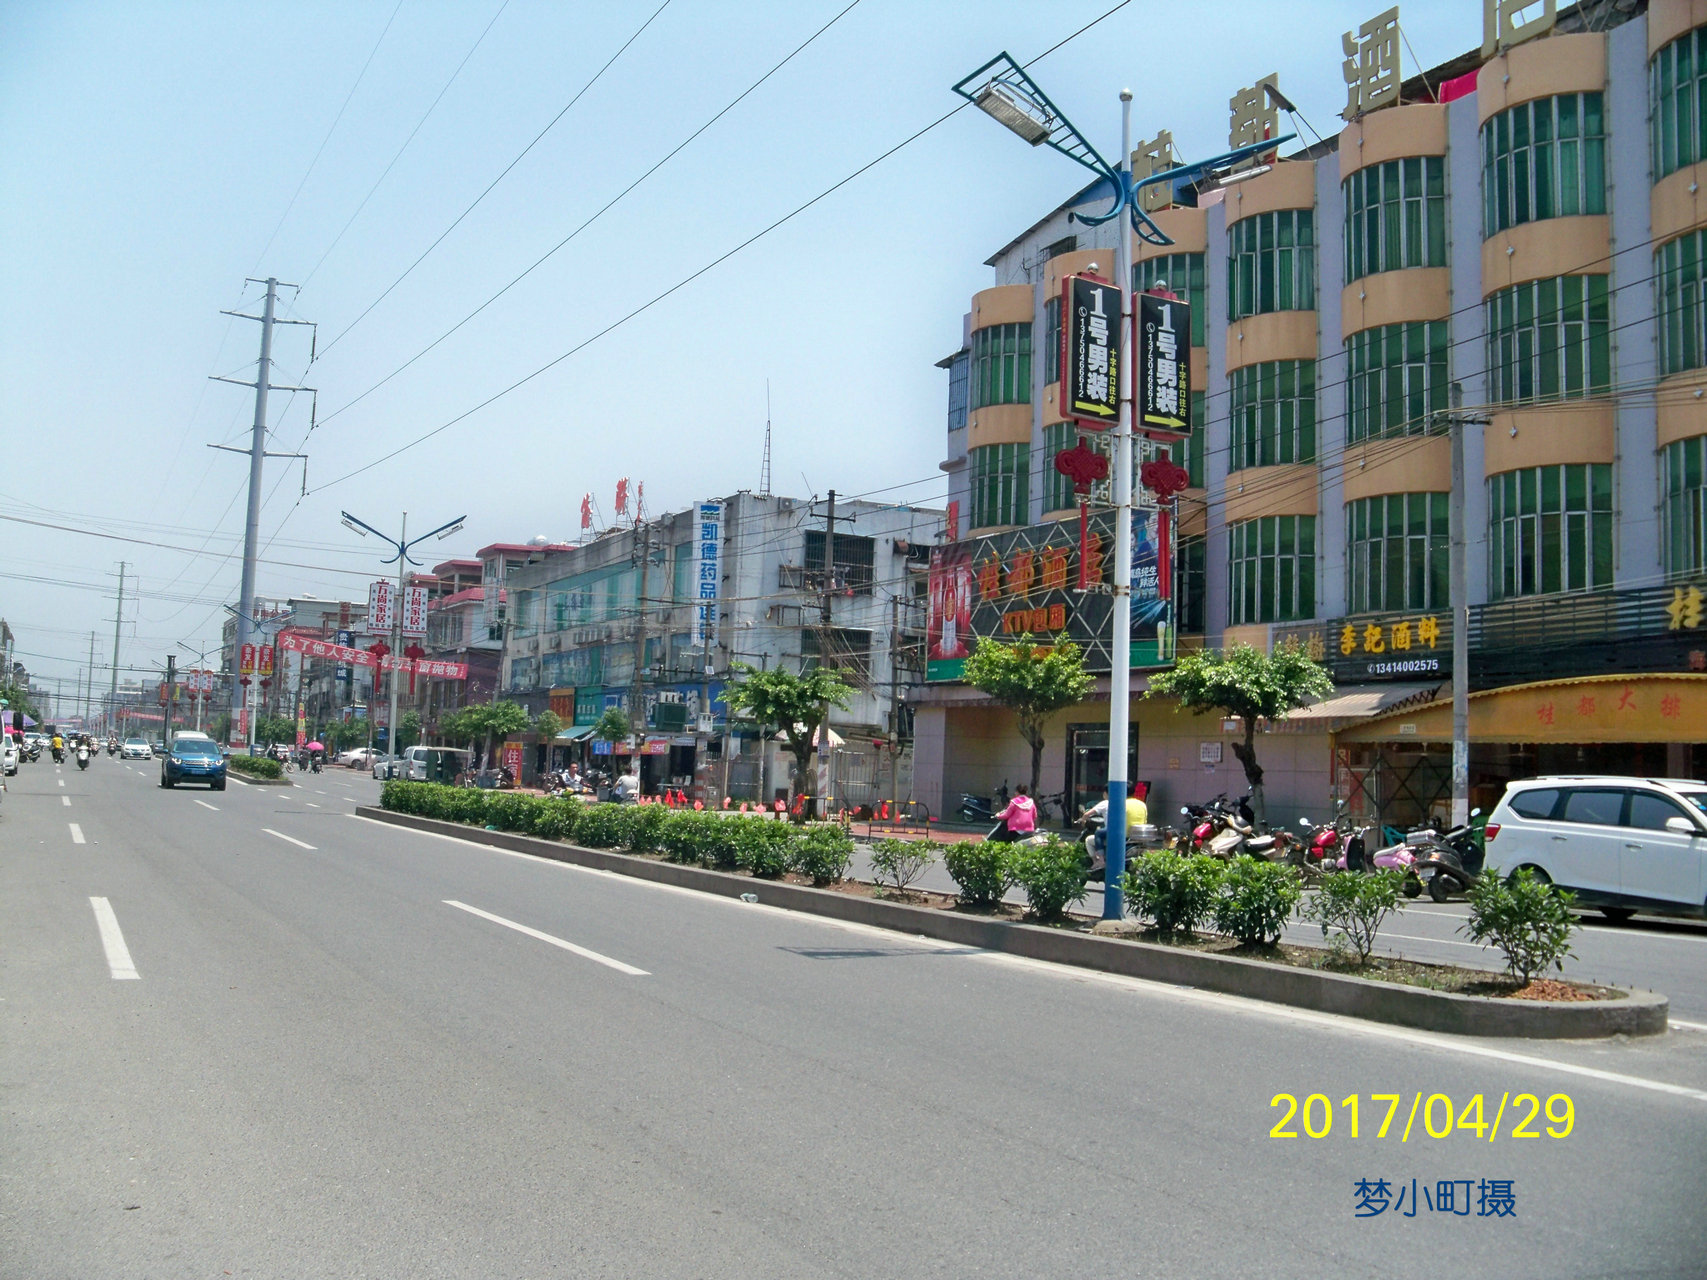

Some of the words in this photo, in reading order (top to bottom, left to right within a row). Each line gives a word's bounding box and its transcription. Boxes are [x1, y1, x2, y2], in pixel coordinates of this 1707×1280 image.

[1078, 318, 1086, 398] 13750466612
[1087, 288, 1108, 402] 1号男装
[1156, 303, 1177, 415] 1号男装
[376, 586, 388, 623] 万尚家居
[410, 588, 422, 625] 万尚家居
[284, 635, 369, 664] 为了他人安全
[1375, 659, 1438, 674] 13414002575
